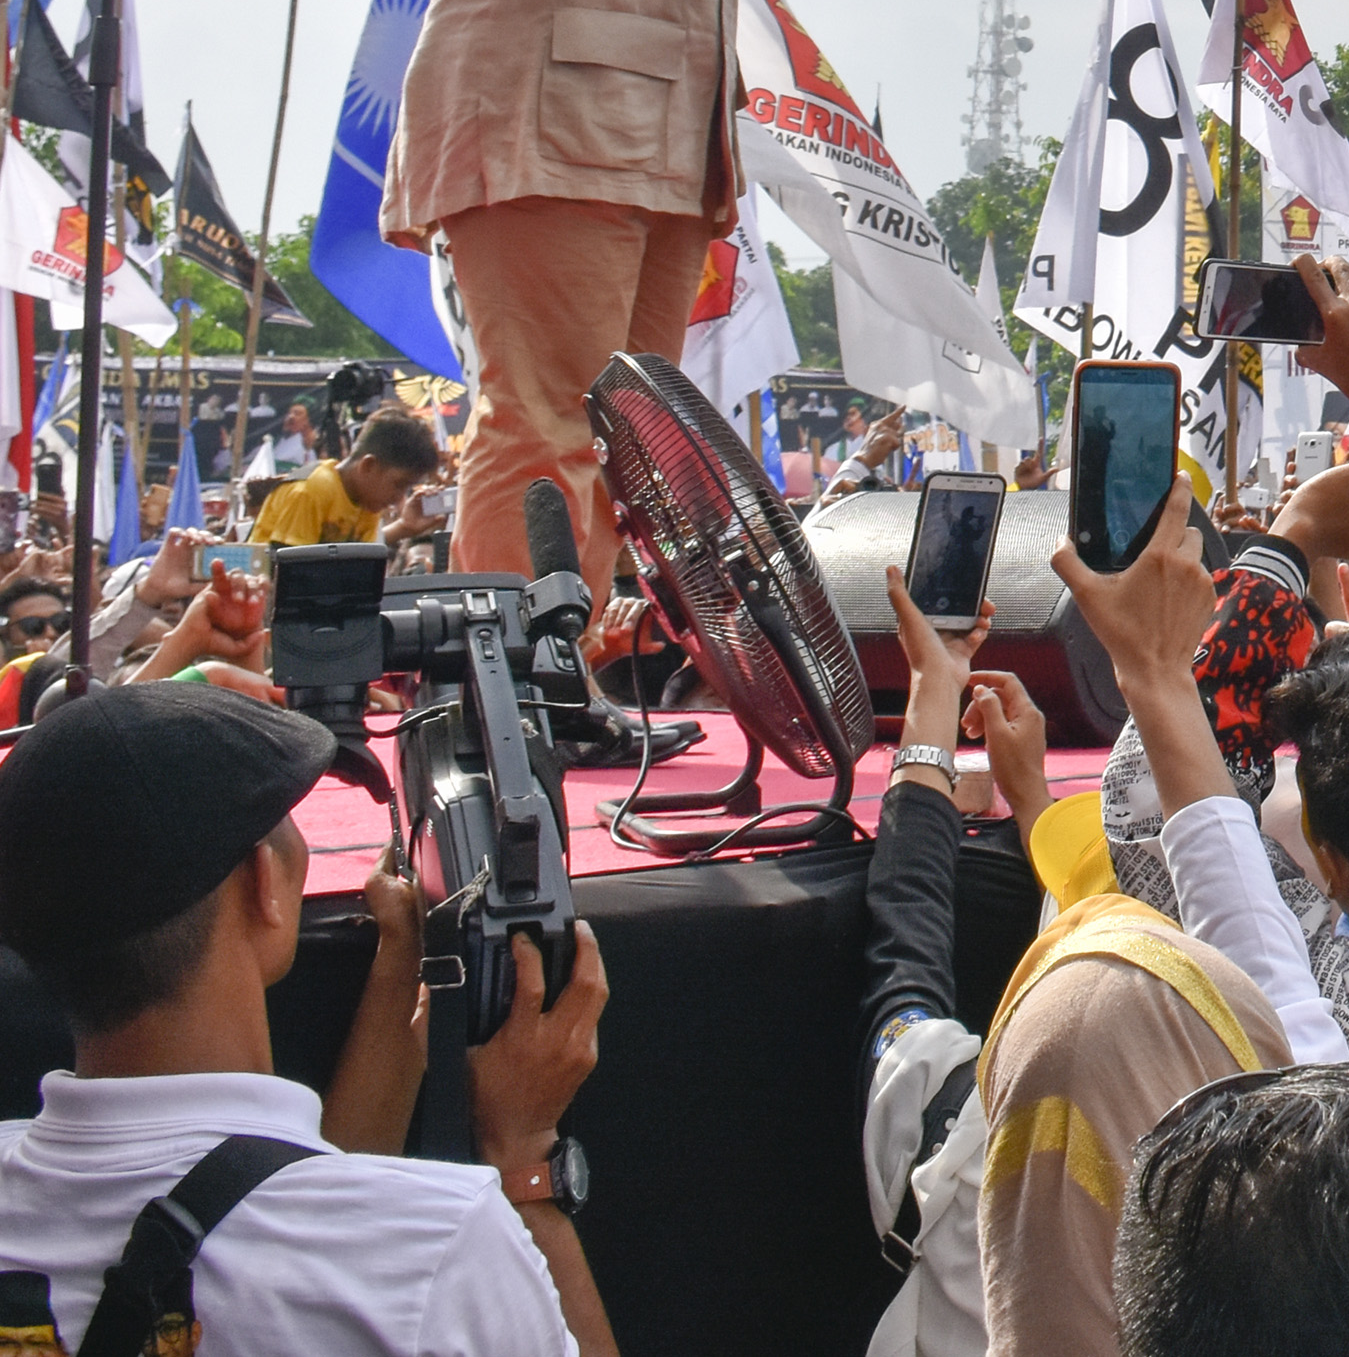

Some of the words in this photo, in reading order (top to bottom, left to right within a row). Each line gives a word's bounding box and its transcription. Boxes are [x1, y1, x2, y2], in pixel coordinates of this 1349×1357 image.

[744, 87, 898, 171] GERIND
[825, 145, 903, 189] INDONESIA
[31, 249, 115, 298] GERINA
